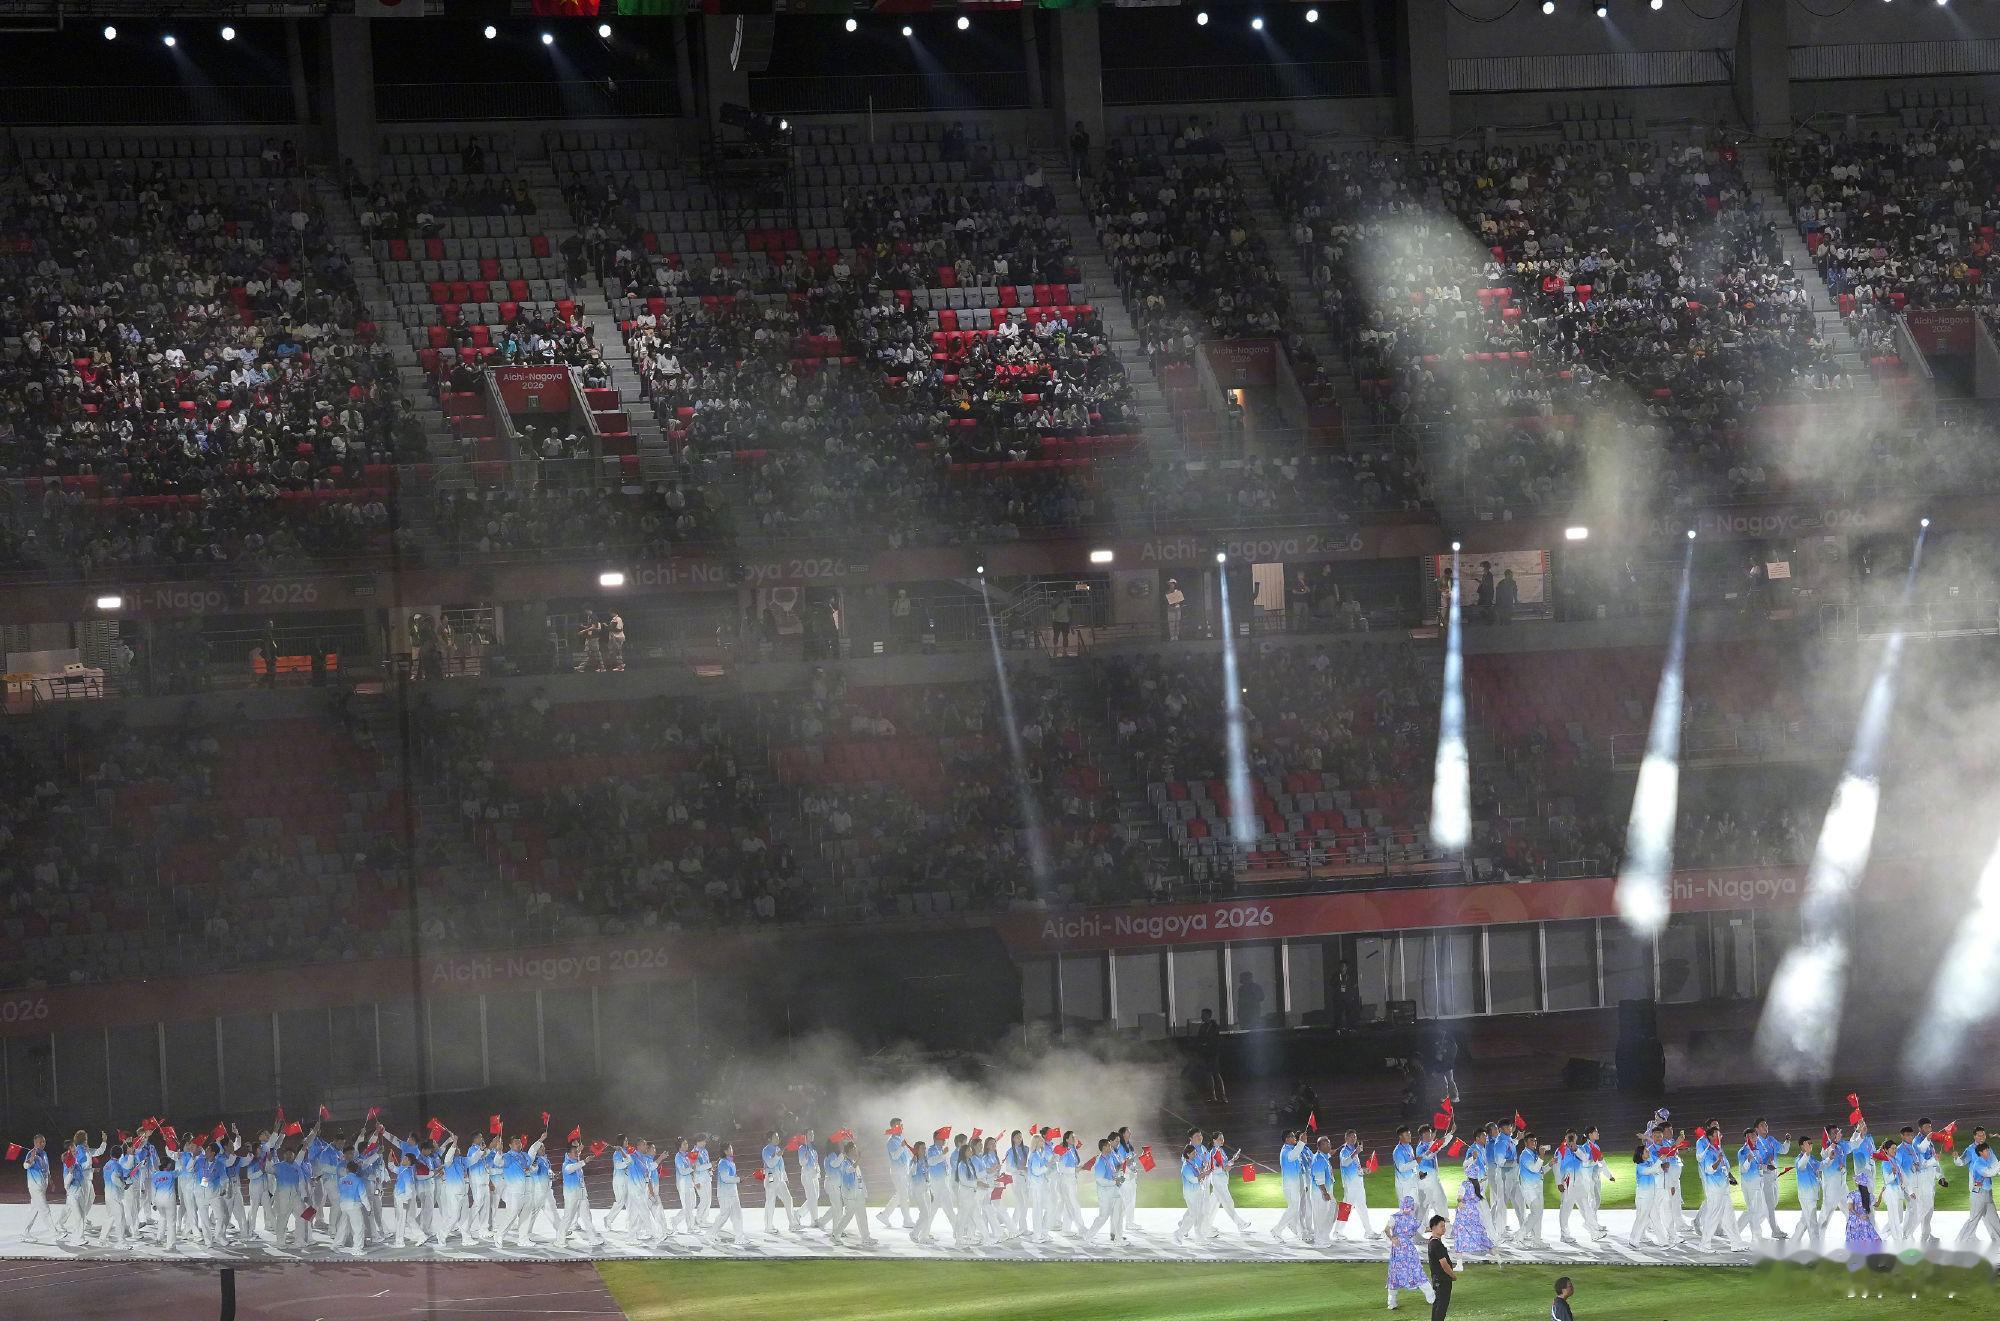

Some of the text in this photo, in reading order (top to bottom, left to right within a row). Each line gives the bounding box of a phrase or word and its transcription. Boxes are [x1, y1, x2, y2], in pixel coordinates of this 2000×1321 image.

[503, 372, 563, 382] Aichi-Nagoya
[522, 381, 544, 390] 2026
[1649, 514, 1801, 537] Aici-Nagoya
[1815, 507, 1863, 528] 026
[1141, 538, 1298, 562] Aichi-agoya
[788, 558, 846, 578] 2026
[256, 583, 318, 605] 2026
[1662, 876, 1796, 902] chi-Nagoya
[1042, 906, 1274, 938] Aichi-Nagoya 2026
[432, 947, 669, 982] Aichi-Nagoya 2026
[1, 998, 48, 1022] 026
